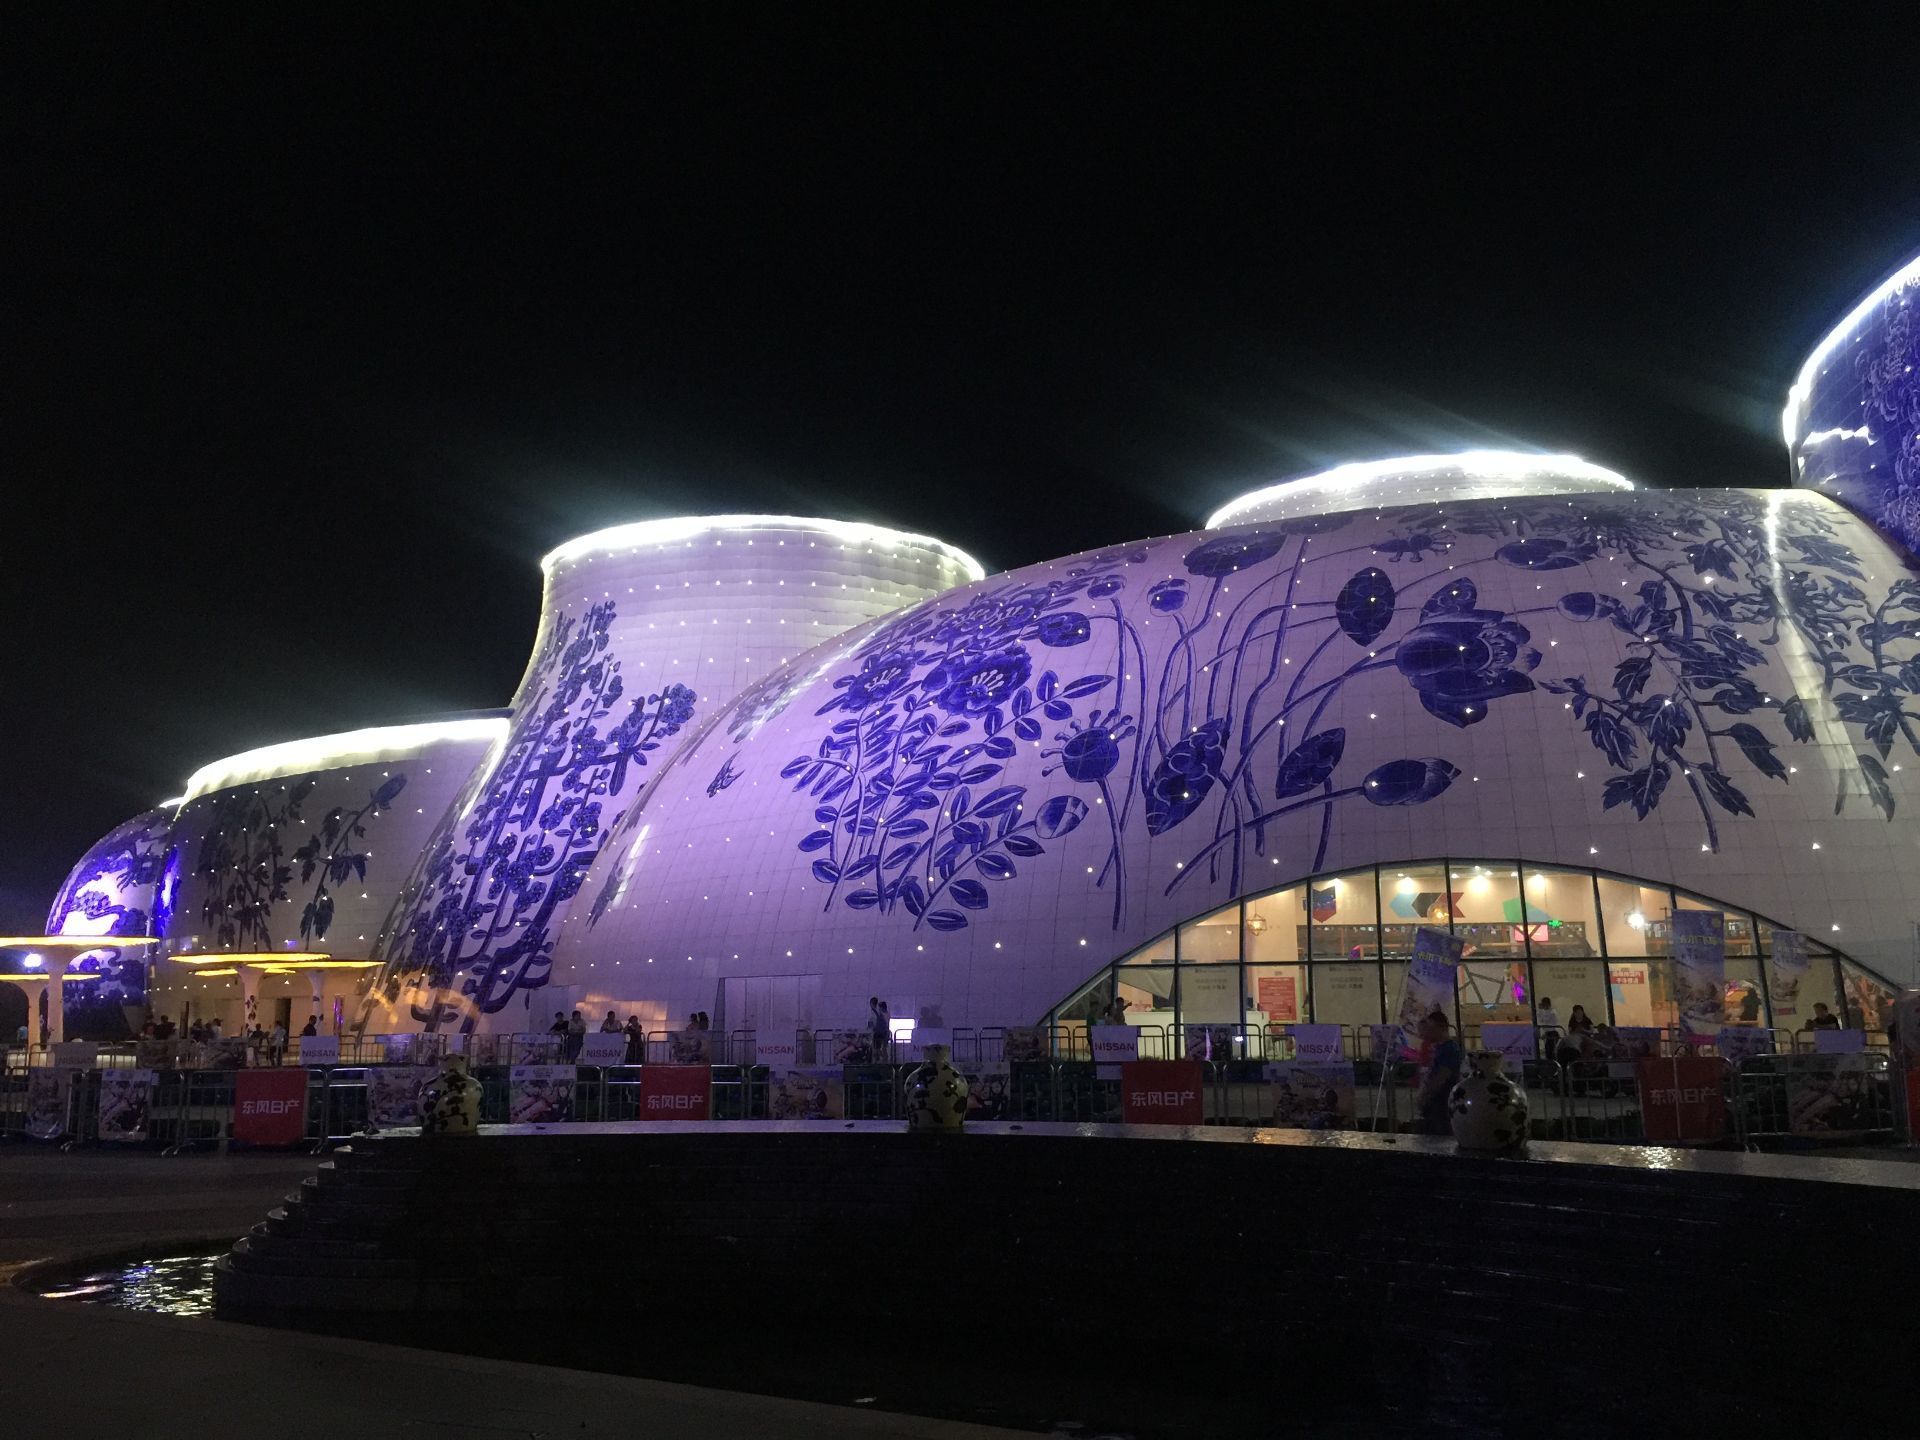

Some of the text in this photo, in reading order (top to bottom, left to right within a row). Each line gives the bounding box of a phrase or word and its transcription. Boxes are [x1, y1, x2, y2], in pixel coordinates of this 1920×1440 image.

[757, 1046, 795, 1055] NISSAN
[1094, 1042, 1135, 1052] NISSAN
[1298, 1044, 1339, 1054] NISSAN
[302, 1049, 336, 1058] NISSAN
[586, 1048, 621, 1058] NISSAN
[1130, 1089, 1196, 1107] 东风日产
[1649, 1086, 1719, 1106] 东风日产
[647, 1093, 704, 1110] 东风日产
[241, 1099, 300, 1115] 东风日产
